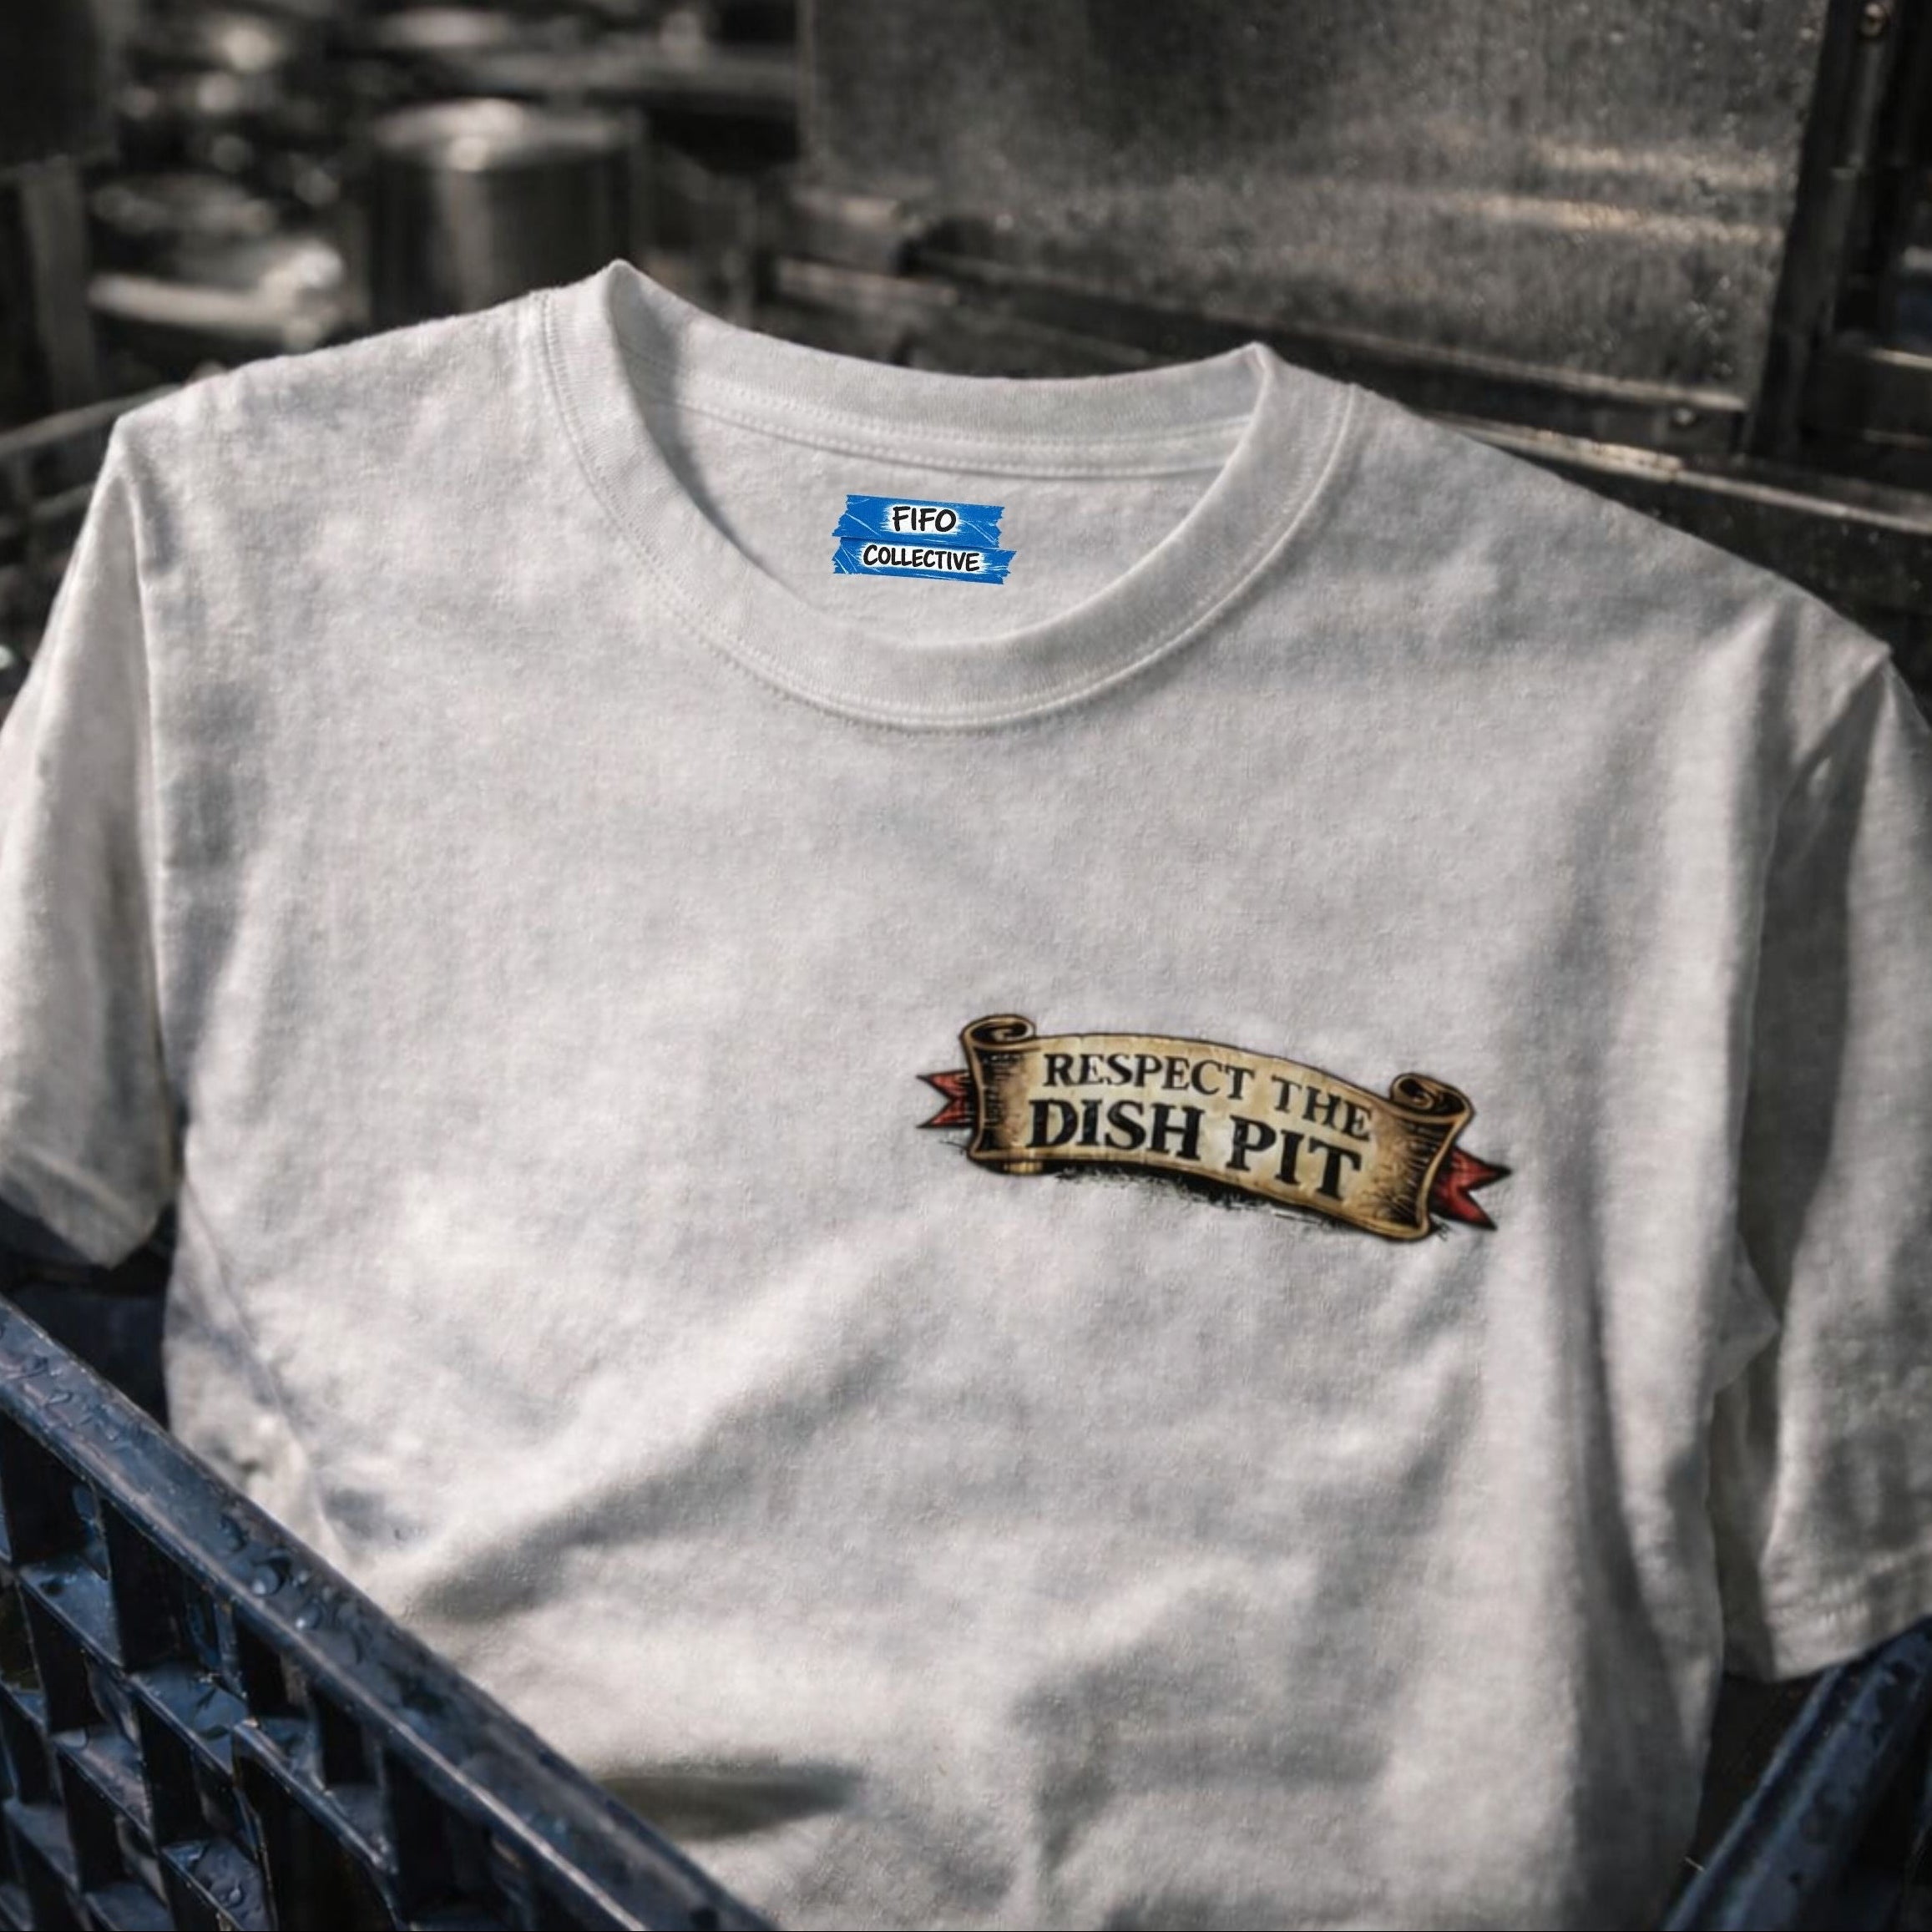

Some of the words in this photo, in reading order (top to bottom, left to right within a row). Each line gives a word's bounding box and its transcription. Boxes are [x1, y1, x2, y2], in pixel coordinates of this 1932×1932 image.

[892, 505, 957, 532] FIFO
[862, 544, 979, 572] COLLECTIVE
[1043, 1052, 1254, 1100] RESPECT
[1271, 1074, 1373, 1142] THE
[1026, 1097, 1203, 1161] DISH
[1226, 1114, 1362, 1201] PIT
